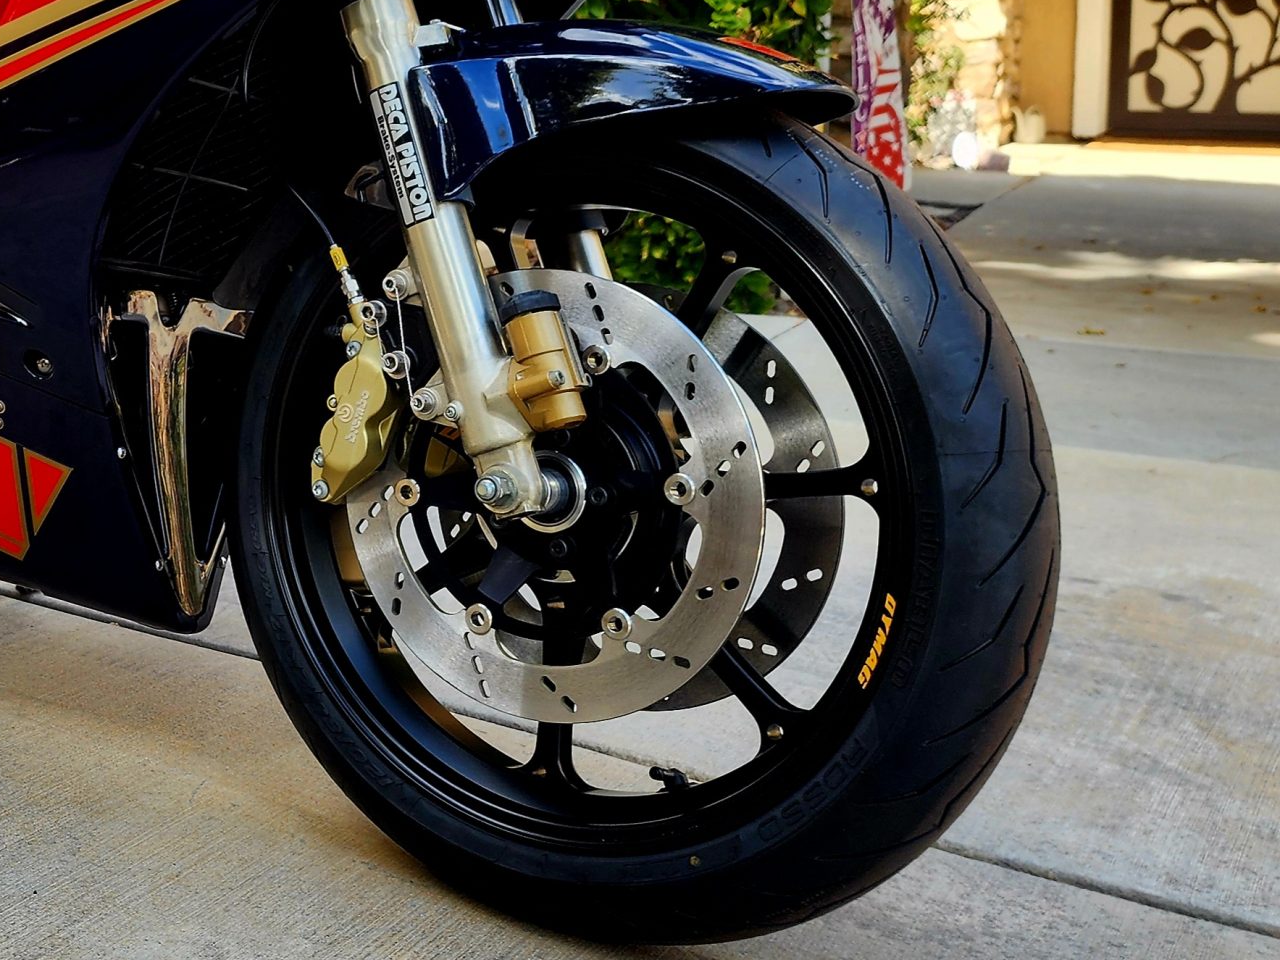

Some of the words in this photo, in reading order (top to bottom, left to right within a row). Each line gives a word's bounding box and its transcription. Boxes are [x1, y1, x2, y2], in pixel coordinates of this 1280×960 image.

[379, 83, 409, 142] DECA
[395, 141, 434, 221] PISTON
[345, 390, 370, 444] brembo
[857, 593, 897, 690] DYMAG
[756, 737, 869, 843] ROSSO
